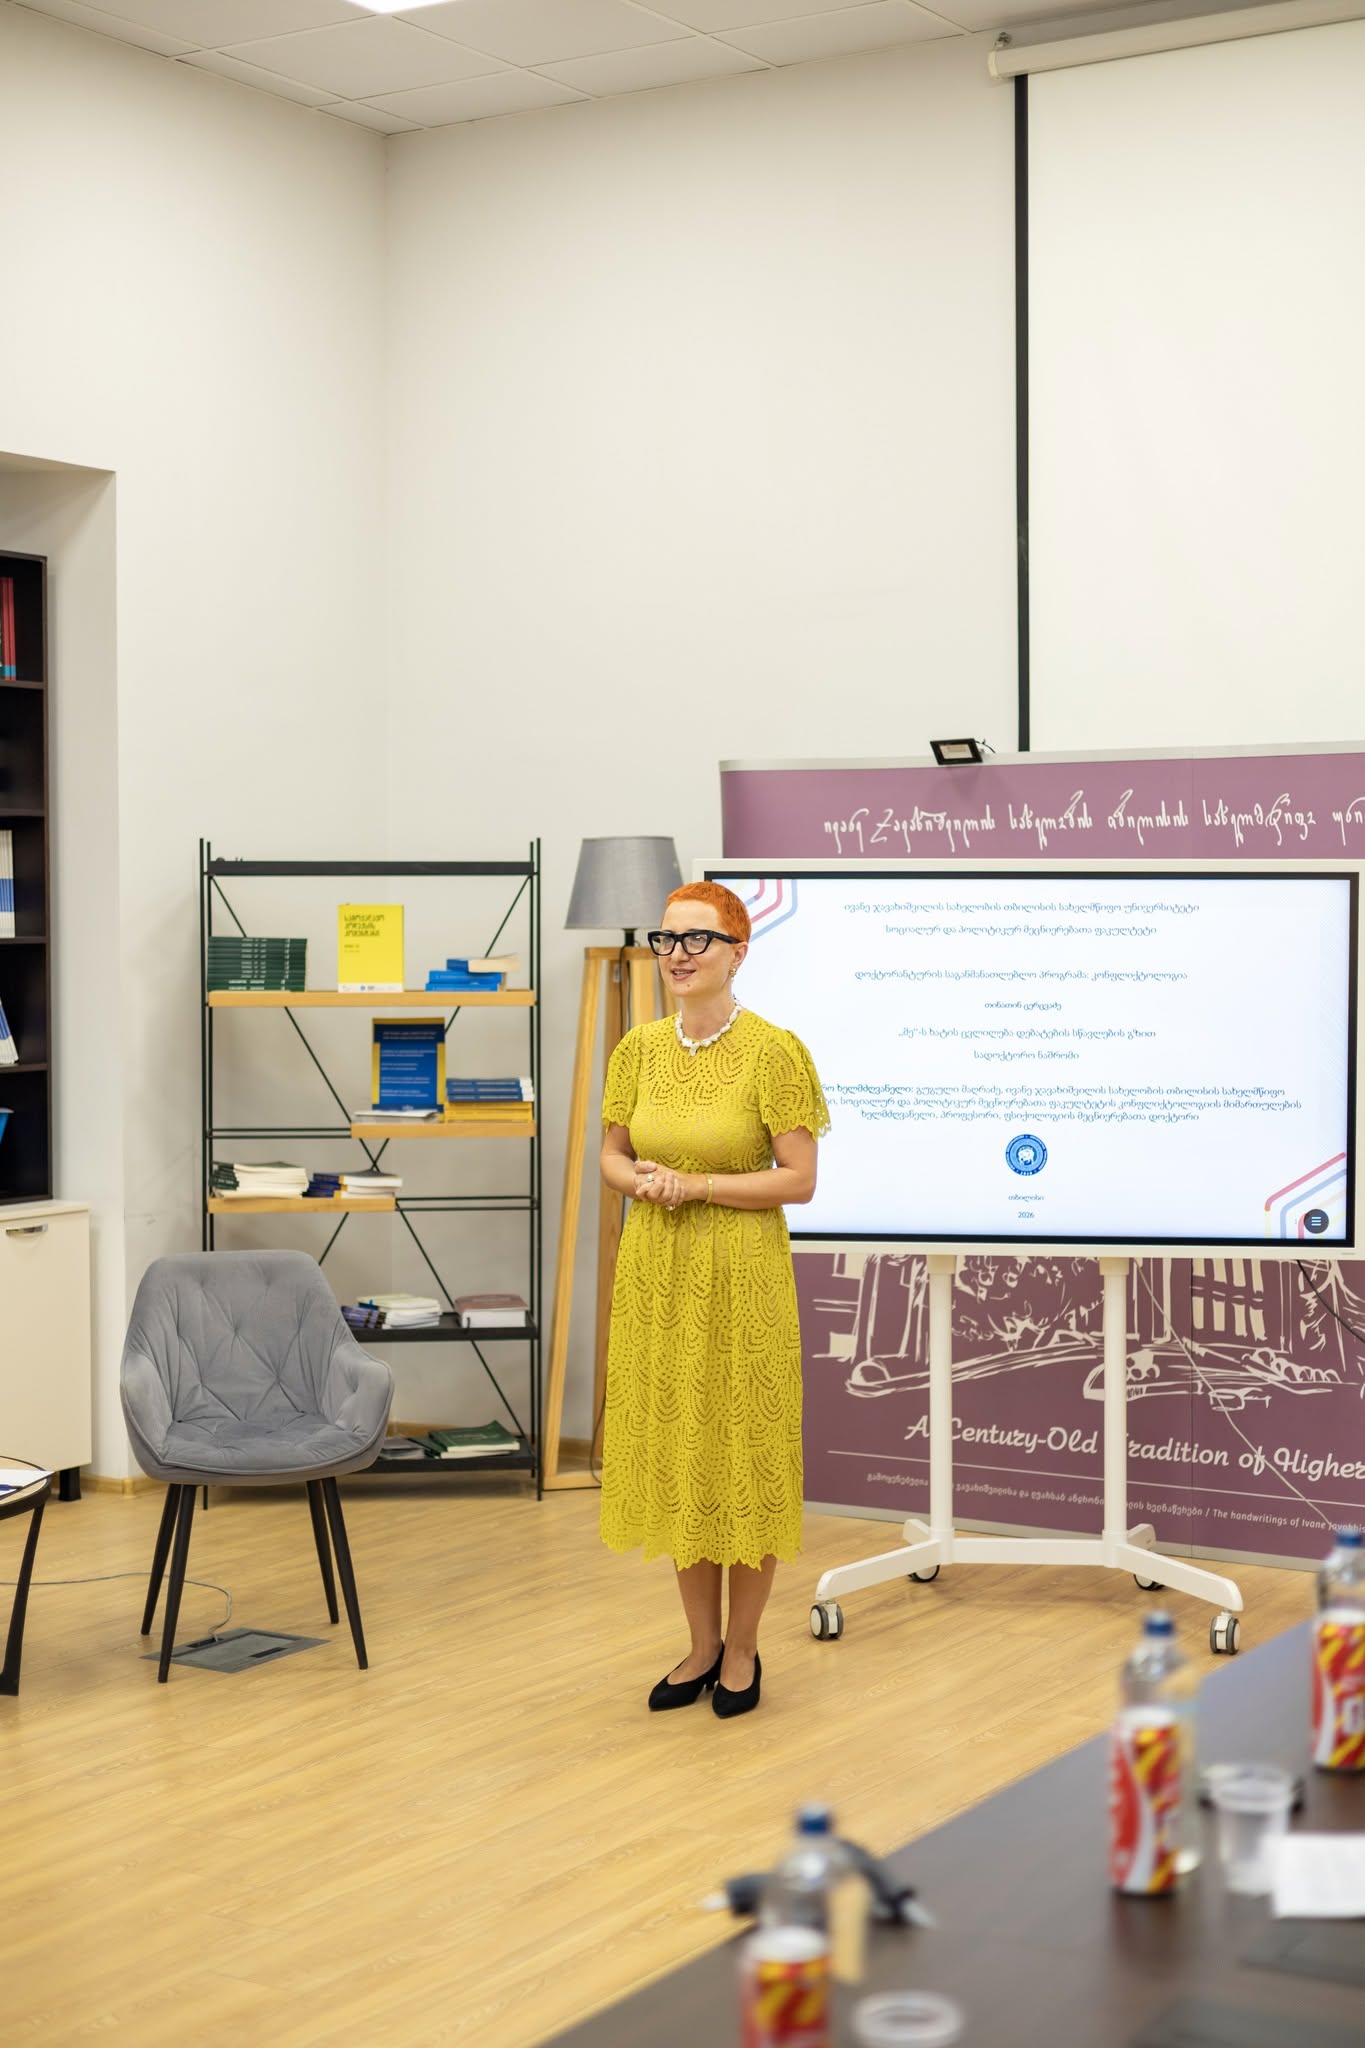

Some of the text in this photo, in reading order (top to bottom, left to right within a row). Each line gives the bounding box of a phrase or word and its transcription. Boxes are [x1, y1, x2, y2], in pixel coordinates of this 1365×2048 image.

[844, 902, 1199, 915] ივანე ჯავახიშვილის სახელობის თბილისის სახელმწიფო უნივერსიტეტი
[886, 925, 1157, 937] სოციალურ და პოლიტიკურ მეცნიერებათა ფაკულტეტი
[855, 969, 942, 982] დოქტორანტურის
[945, 969, 1036, 982] საგანმანათლებლო
[1091, 970, 1188, 982] კონფლიქტოლოგია
[929, 1028, 958, 1039] ხატის
[961, 1028, 1013, 1040] ცვლილება
[1016, 1028, 1070, 1040] დებატების
[1072, 1028, 1125, 1040] სწავლების
[974, 1050, 1080, 1061] სადოქტორო ნაშრომი
[837, 1084, 913, 1095] ხელმძღვანელი:
[1006, 1086, 1032, 1097] ივანე
[1035, 1085, 1106, 1097] ჯავახიშვილის
[1109, 1086, 1164, 1097] სახელობის
[1166, 1087, 1219, 1098] თბილისის
[1222, 1087, 1285, 1099] სახელმწიფო
[840, 1096, 895, 1108] სოციალურ
[897, 1098, 911, 1108] და
[913, 1097, 976, 1109] პოლიტიკურ
[978, 1098, 1046, 1109] მეცნიერებათა
[1048, 1099, 1116, 1110] ფაკულტეტის
[1118, 1099, 1221, 1111] კონფლიქტოლოგიის
[1223, 1100, 1302, 1111] მიმართულების
[1004, 1111, 1075, 1122] ფსიქოლოგიის
[1078, 1111, 1146, 1123] მეცნიერებათა
[1148, 1112, 1200, 1123] დოქტორი
[1008, 1194, 1044, 1203] თბილისი
[904, 1415, 930, 1441] A
[1127, 1433, 1229, 1467] radition
[1239, 1446, 1265, 1476] of
[1273, 1447, 1365, 1483] Higher
[1213, 1508, 1228, 1520] The
[1230, 1510, 1287, 1527] handwritings
[1290, 1517, 1300, 1529] of
[1302, 1518, 1326, 1530] Ivane
